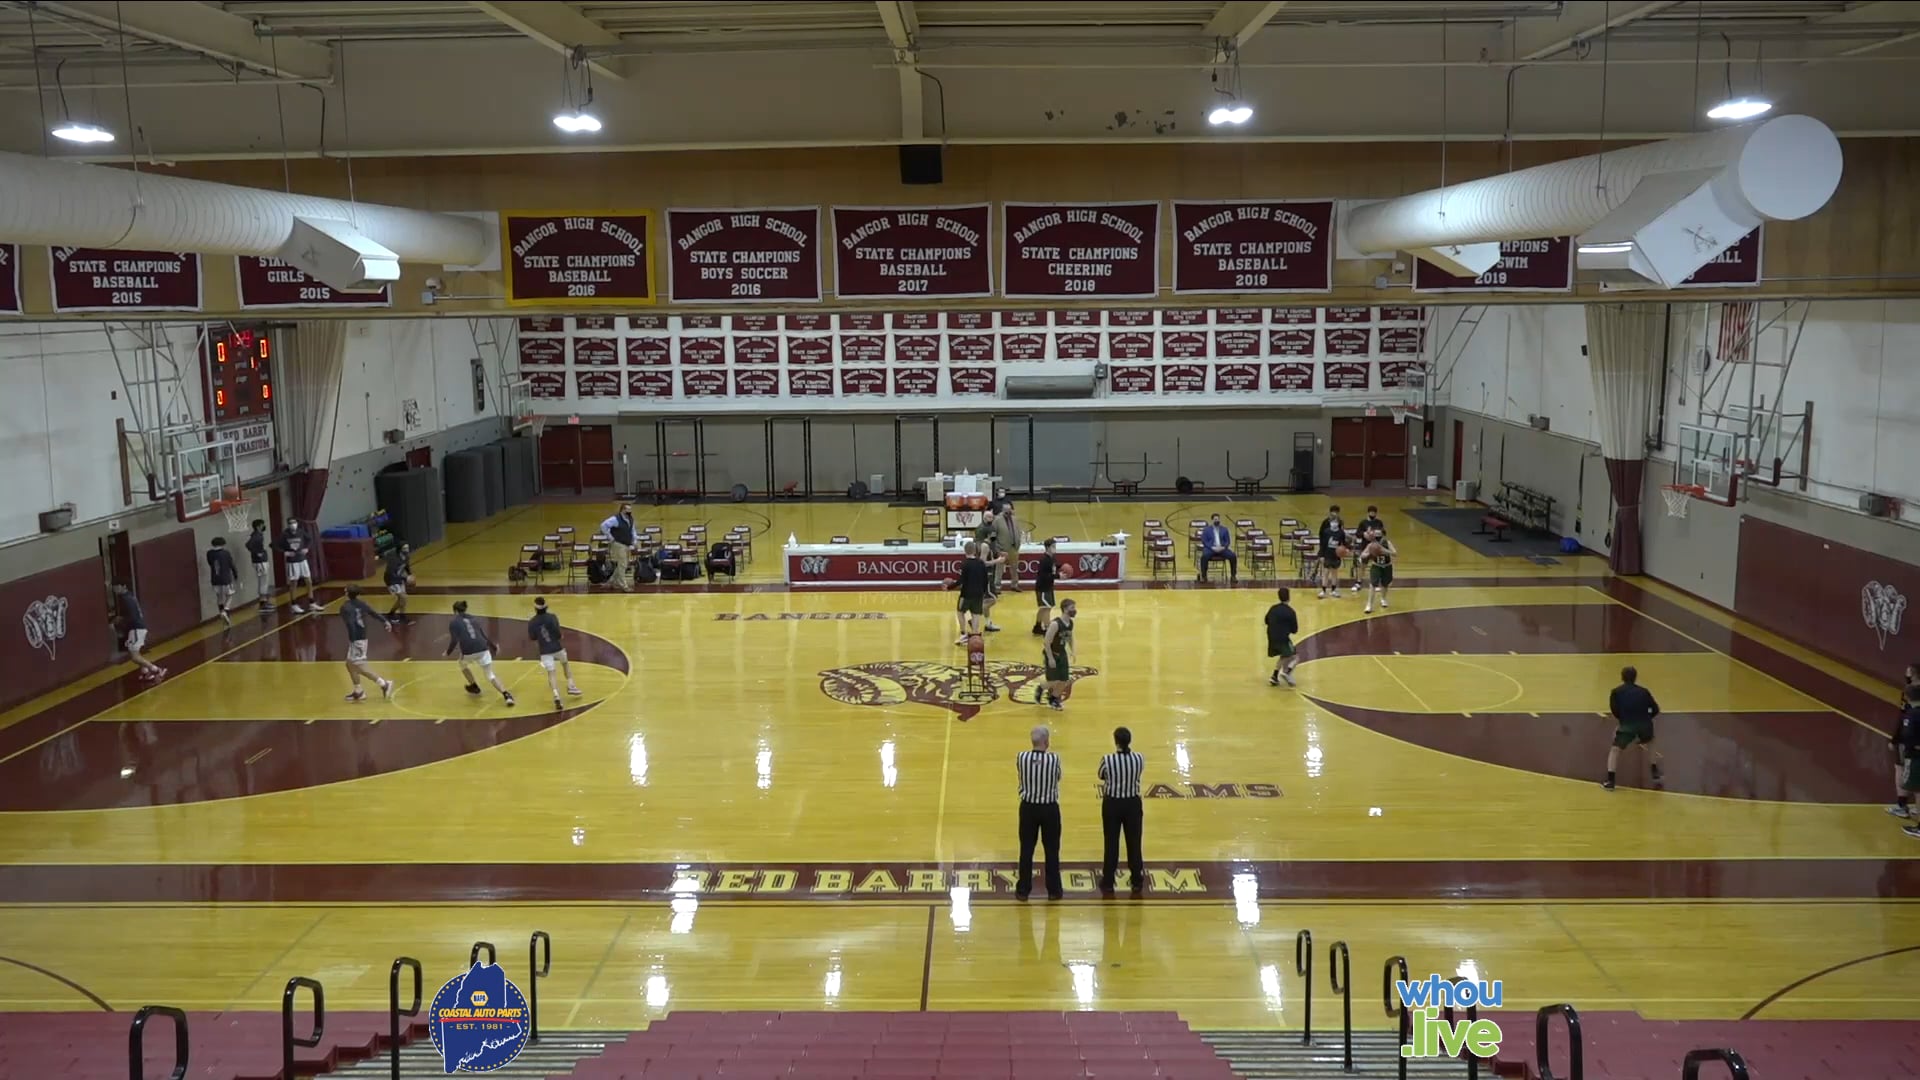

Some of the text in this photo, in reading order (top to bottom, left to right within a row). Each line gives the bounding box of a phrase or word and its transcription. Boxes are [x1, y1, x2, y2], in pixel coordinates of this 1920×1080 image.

[1013, 209, 1145, 244] BANGOR HIGH SCHOOL
[1183, 206, 1319, 243] BANGOR HIGH SCHOOL
[513, 217, 645, 258] BANGOR HIGH SCHOOL
[678, 214, 808, 251] BANGOR HIGH SCHOOL
[841, 213, 981, 250] BANGOR HIGH SCHOOL
[1193, 241, 1312, 256] STATE CHAMPIONS
[1500, 240, 1549, 253] MPIONS
[690, 250, 800, 263] STATE CHAMPIONS
[855, 247, 971, 261] STATE CHAMPIONS
[1021, 247, 1138, 260] STATE CHAMPIONS
[69, 261, 181, 273] STATE CHAMPIONS
[524, 254, 636, 268] STATE CHAMPIONS
[1218, 258, 1288, 271] BASEBALL
[1496, 256, 1528, 269] SWIM
[549, 269, 611, 282] BASEBALL
[700, 267, 788, 280] BOYS SOCCER
[879, 263, 947, 276] BASEBALL
[1047, 263, 1112, 276] CHEERING
[93, 276, 159, 288] BASEBALL
[267, 271, 304, 283] GIRLS
[1236, 274, 1268, 286] 2018
[568, 284, 595, 297] 2016
[731, 283, 761, 296] 2016
[898, 279, 929, 292] 2017
[1064, 279, 1095, 292] 2018
[112, 291, 142, 304] 2015
[299, 287, 330, 299] 2015
[857, 560, 929, 575] BANGOR
[713, 612, 888, 621] BANGOR
[664, 869, 799, 894] RED
